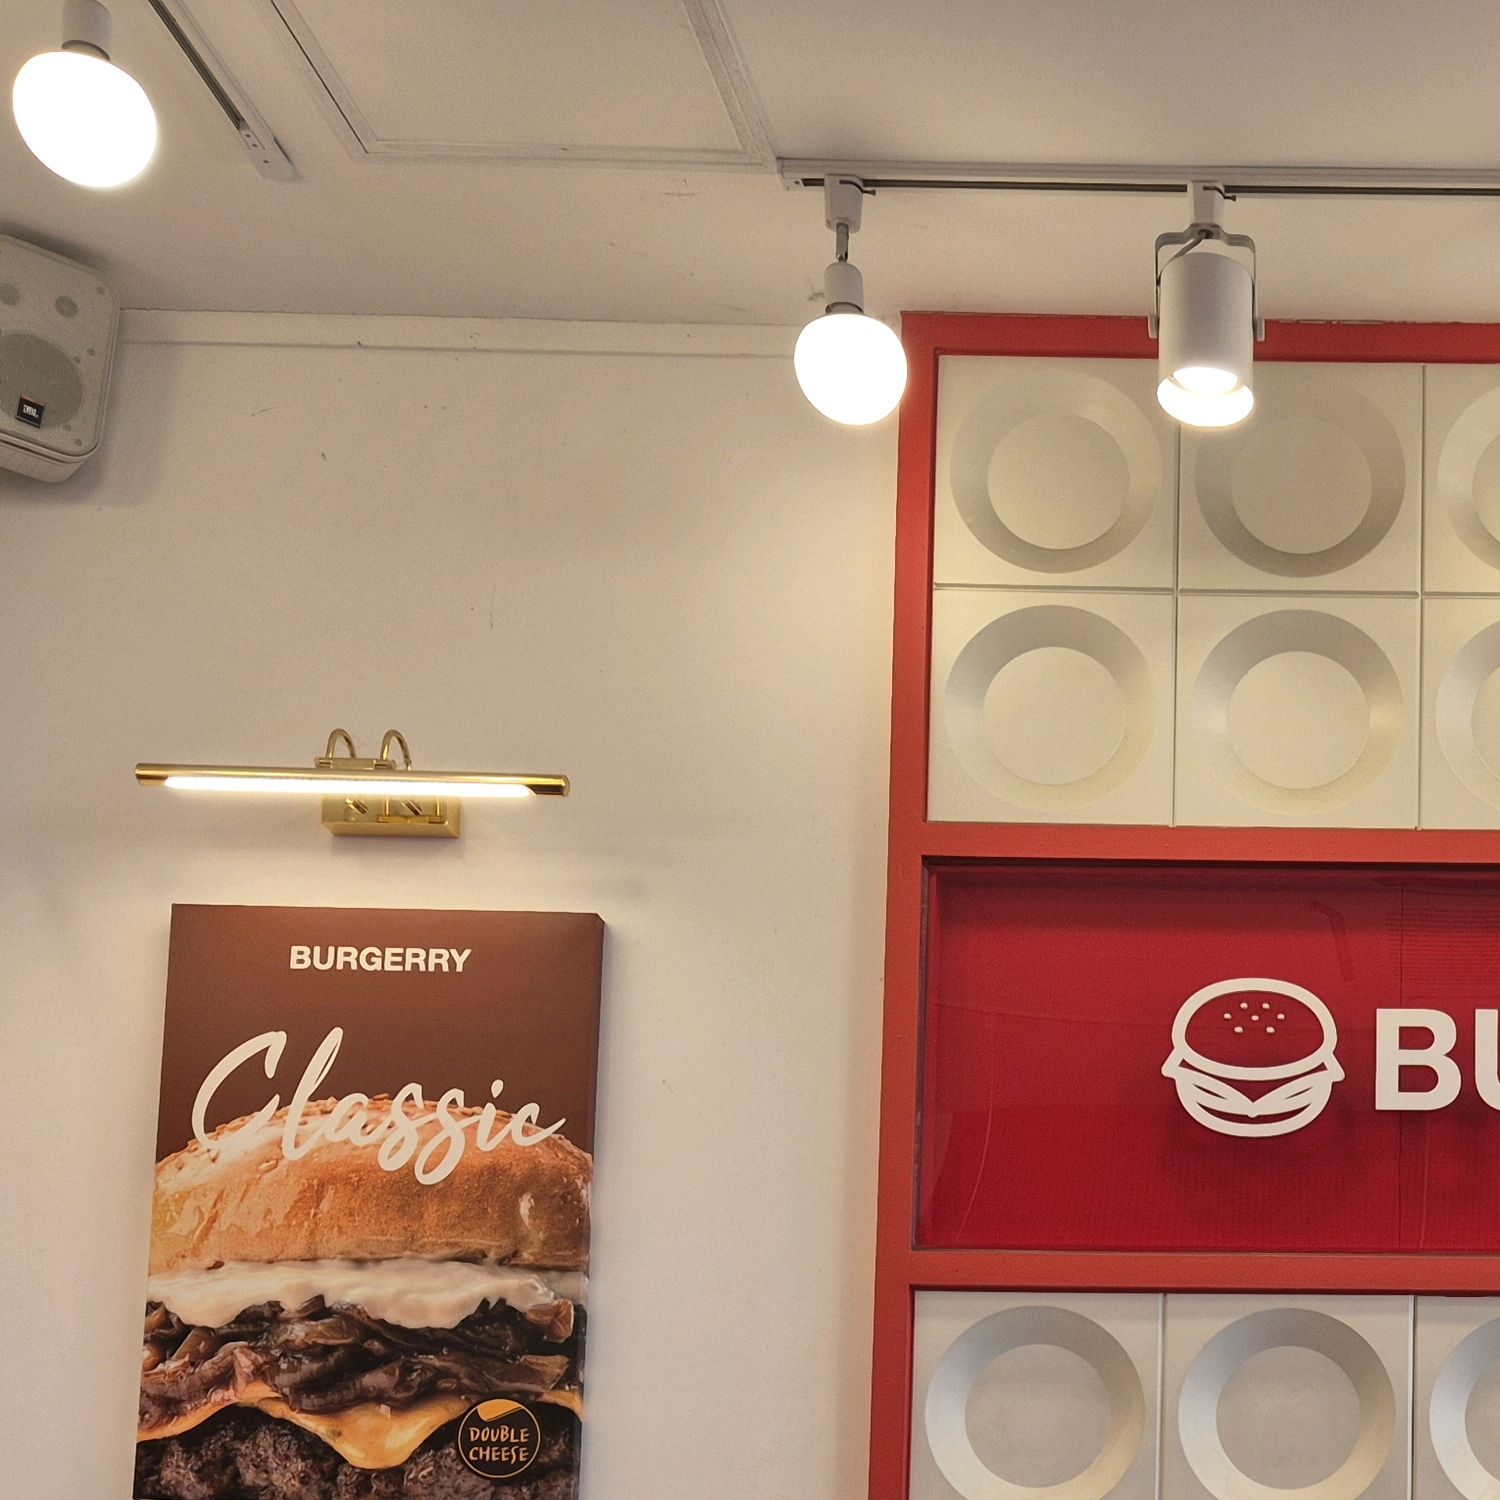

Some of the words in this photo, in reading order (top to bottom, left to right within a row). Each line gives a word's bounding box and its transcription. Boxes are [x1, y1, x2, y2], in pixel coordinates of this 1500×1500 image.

[289, 945, 472, 972] BURGERRY
[191, 1027, 567, 1185] Classic
[469, 1425, 530, 1442] DOUBLE
[469, 1445, 529, 1464] CHEESE
